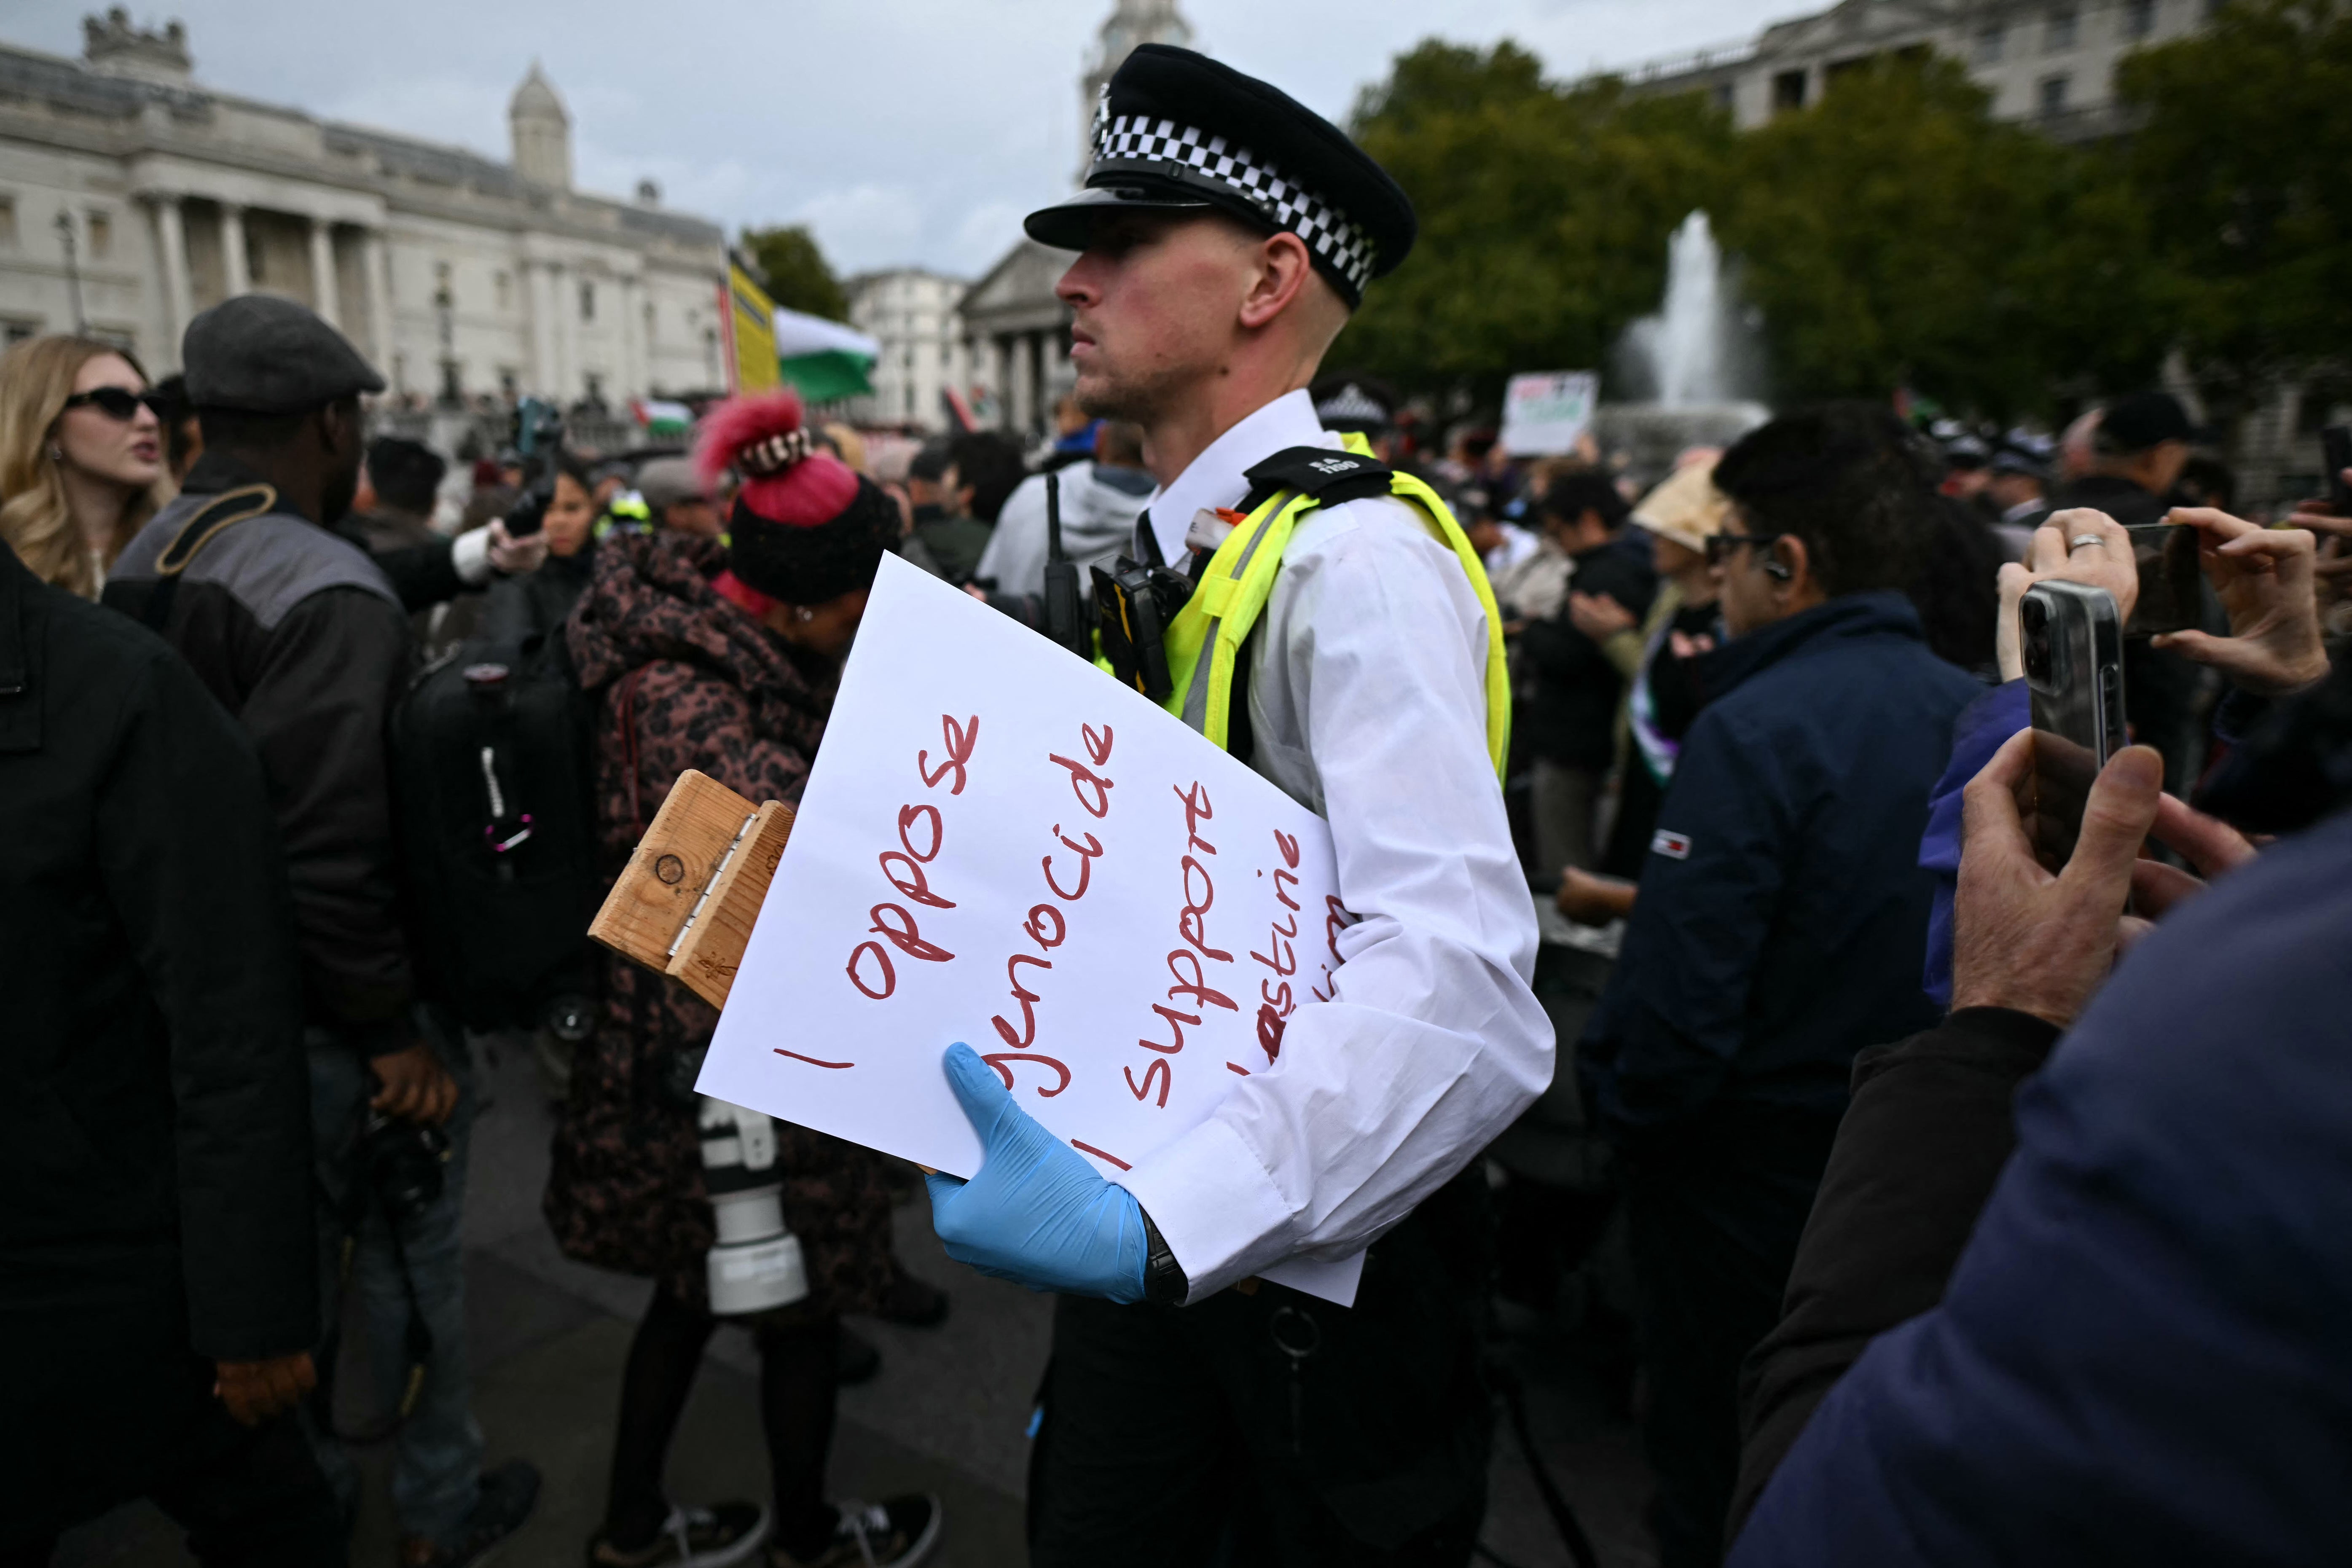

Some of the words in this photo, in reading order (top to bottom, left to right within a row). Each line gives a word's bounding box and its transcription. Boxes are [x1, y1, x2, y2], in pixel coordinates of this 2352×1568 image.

[846, 714, 979, 999] oppose
[981, 722, 1114, 1097] genocide
[1124, 780, 1238, 1109] support
